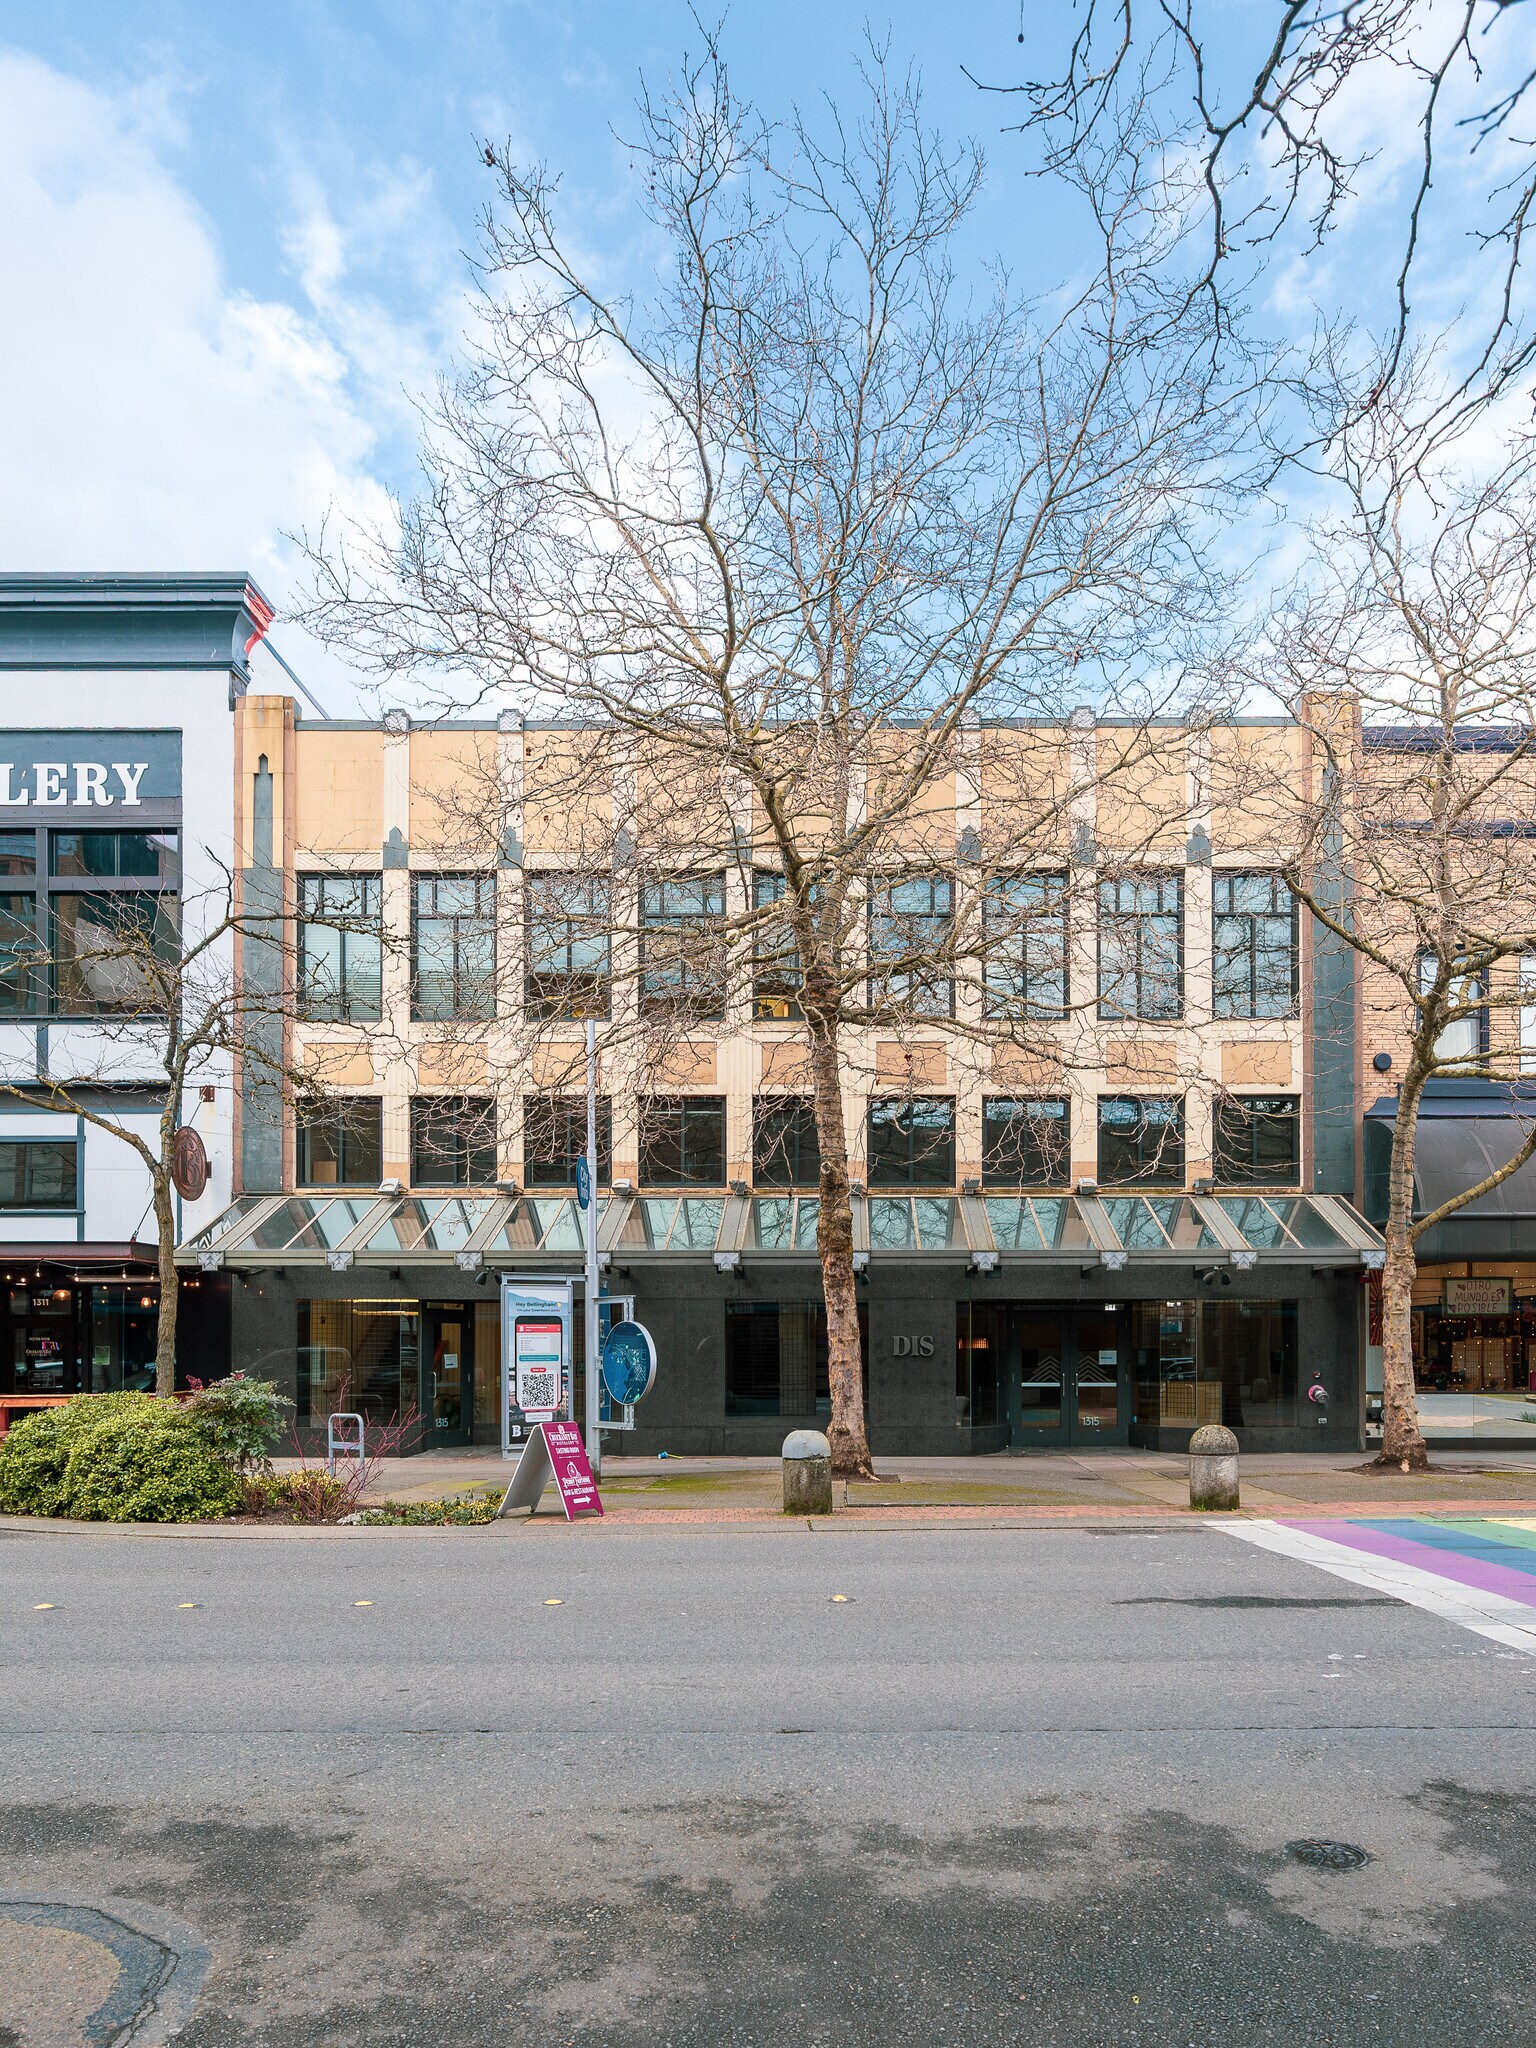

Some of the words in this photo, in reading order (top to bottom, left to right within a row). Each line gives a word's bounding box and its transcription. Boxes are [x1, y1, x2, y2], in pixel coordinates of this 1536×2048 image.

[1466, 1280, 1492, 1291] OTRO
[1454, 1292, 1489, 1302] MUNDO
[1491, 1292, 1501, 1302] ES
[32, 1298, 50, 1307] 1311
[1457, 1303, 1498, 1313] POSIBLE
[892, 1335, 934, 1357] DIS
[435, 1417, 449, 1427] 1315
[1081, 1416, 1100, 1426] 1315
[511, 1425, 522, 1437] B
